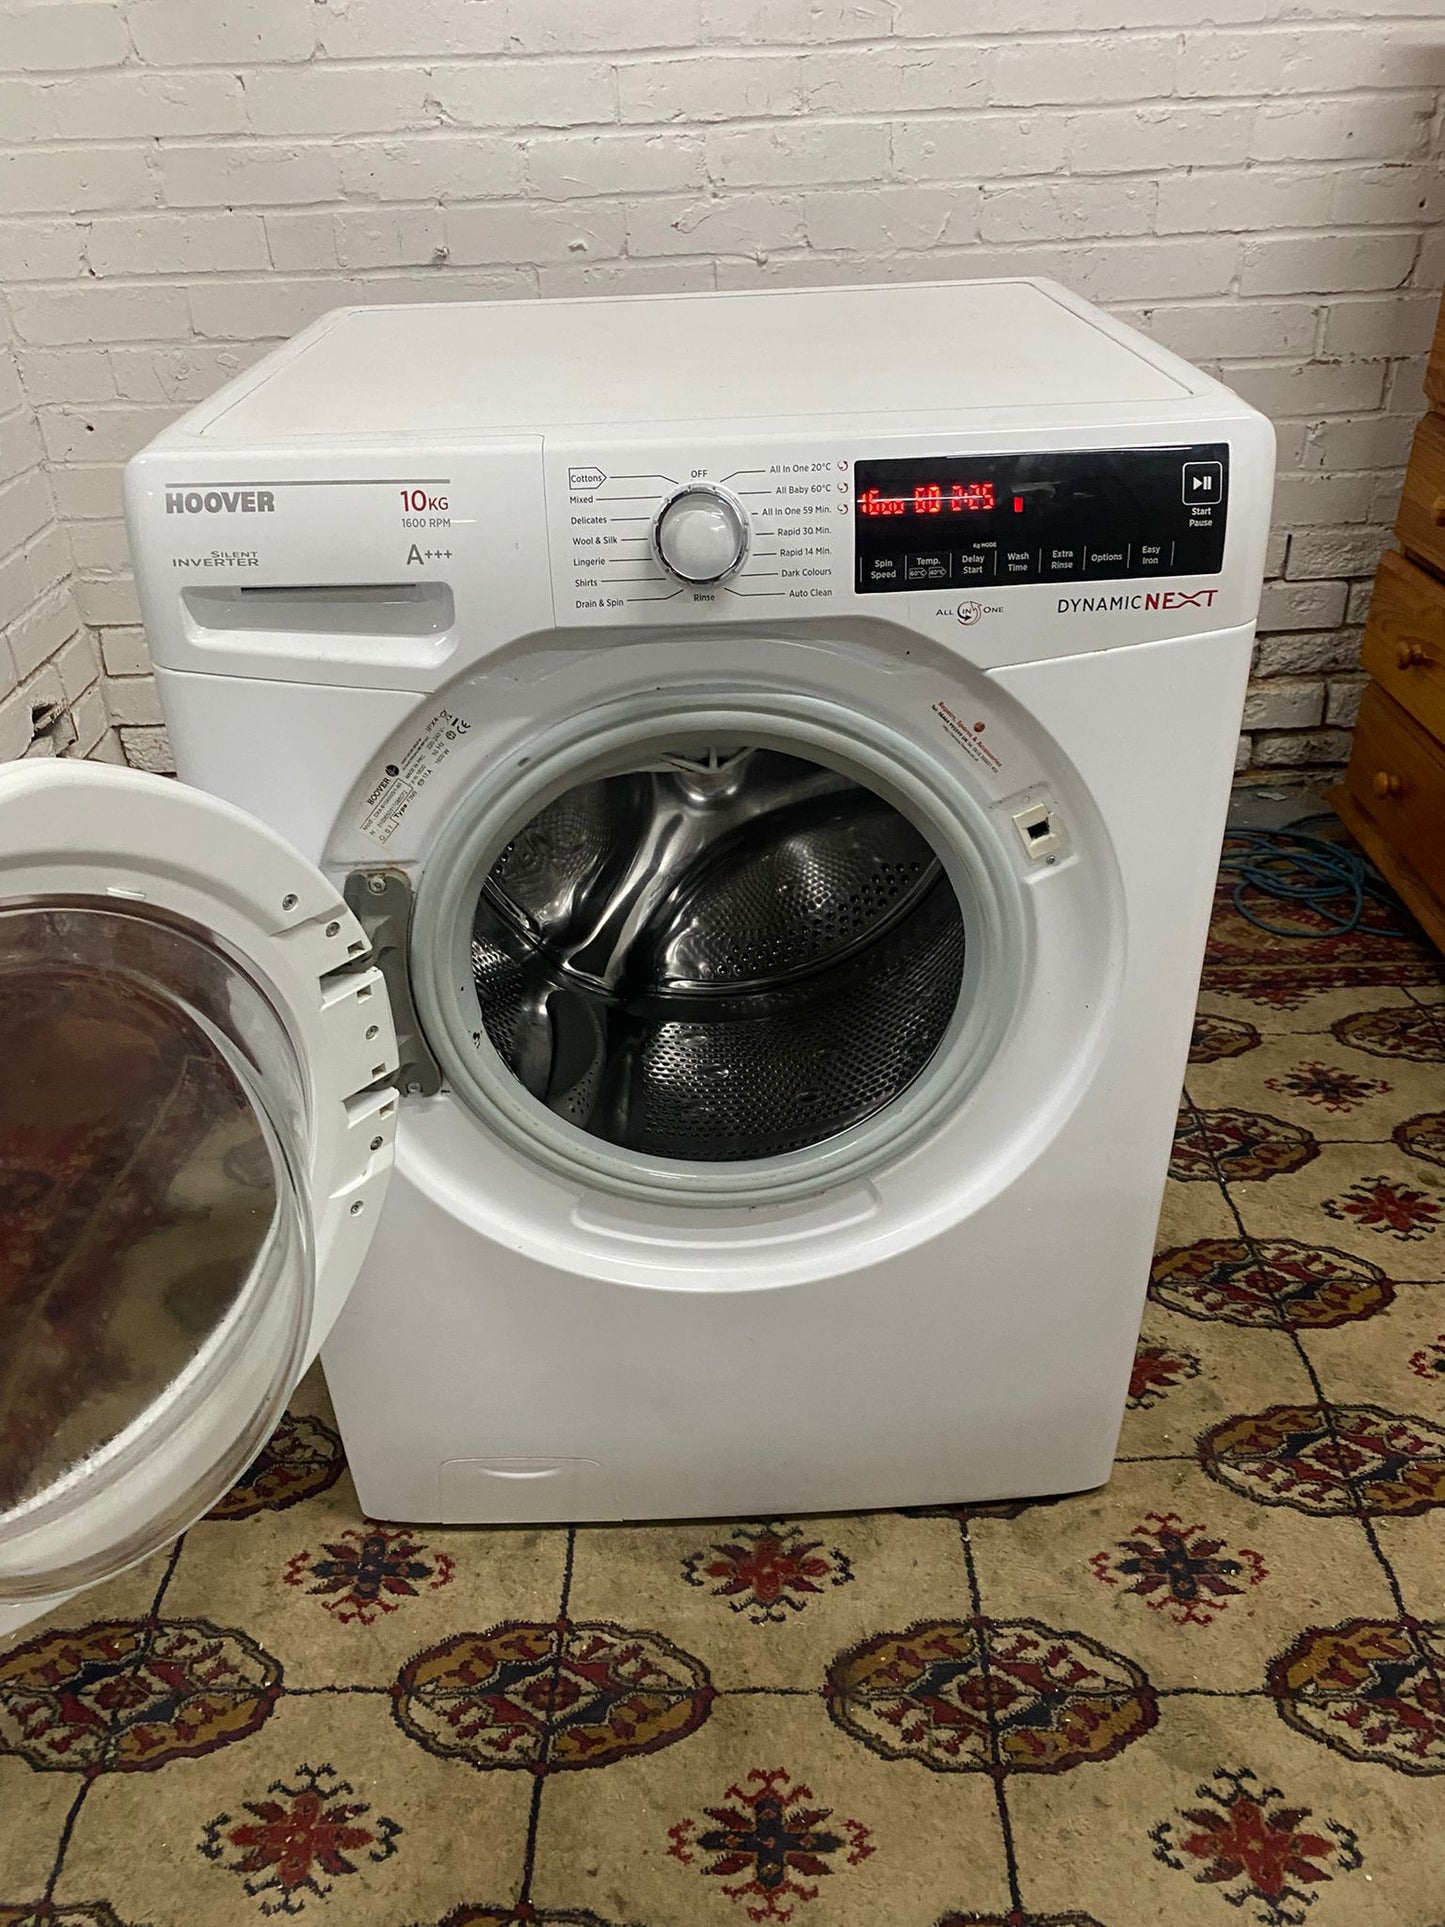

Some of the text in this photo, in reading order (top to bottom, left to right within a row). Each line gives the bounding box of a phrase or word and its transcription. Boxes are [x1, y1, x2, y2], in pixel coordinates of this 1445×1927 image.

[770, 462, 832, 474] All In One 20°C
[570, 474, 602, 483] Cottons
[690, 470, 708, 478] OFF
[776, 484, 832, 495] All Baby 60°C
[165, 491, 275, 514] HOOVER
[400, 489, 449, 512] 10KG
[570, 495, 594, 504] Mixed
[762, 505, 832, 516] All In One 59 Min.
[1191, 507, 1211, 516] Start
[401, 518, 451, 528] 1600 RPM
[571, 516, 608, 526] Delicates
[1189, 518, 1213, 527] Pause
[778, 526, 832, 537] Rapid 30 Min.
[572, 537, 593, 545] Wool
[603, 536, 618, 544] Silk
[780, 546, 832, 557] Rapid 14 Min.
[1052, 550, 1073, 558] Extra
[1142, 546, 1160, 554] Easy
[406, 544, 452, 566] A+++
[962, 555, 985, 563] Delay
[1007, 552, 1029, 560] Wash
[1091, 553, 1123, 562] Options
[172, 558, 259, 567] INVERTER
[573, 557, 605, 567] Lingerie
[874, 559, 893, 568] Spin
[1143, 556, 1158, 564] Iron
[1008, 563, 1028, 571] Time
[1052, 561, 1073, 569] Rinse
[782, 567, 832, 577] Dark Colours
[963, 566, 982, 574] Start
[871, 570, 896, 580] Speed
[575, 578, 598, 587] Shirts
[694, 593, 715, 602] Rinse
[789, 588, 832, 598] Auto Clean
[576, 600, 597, 608] Drain
[607, 598, 624, 608] Spin
[367, 776, 390, 805] HOOVER
[394, 803, 408, 819] Type
